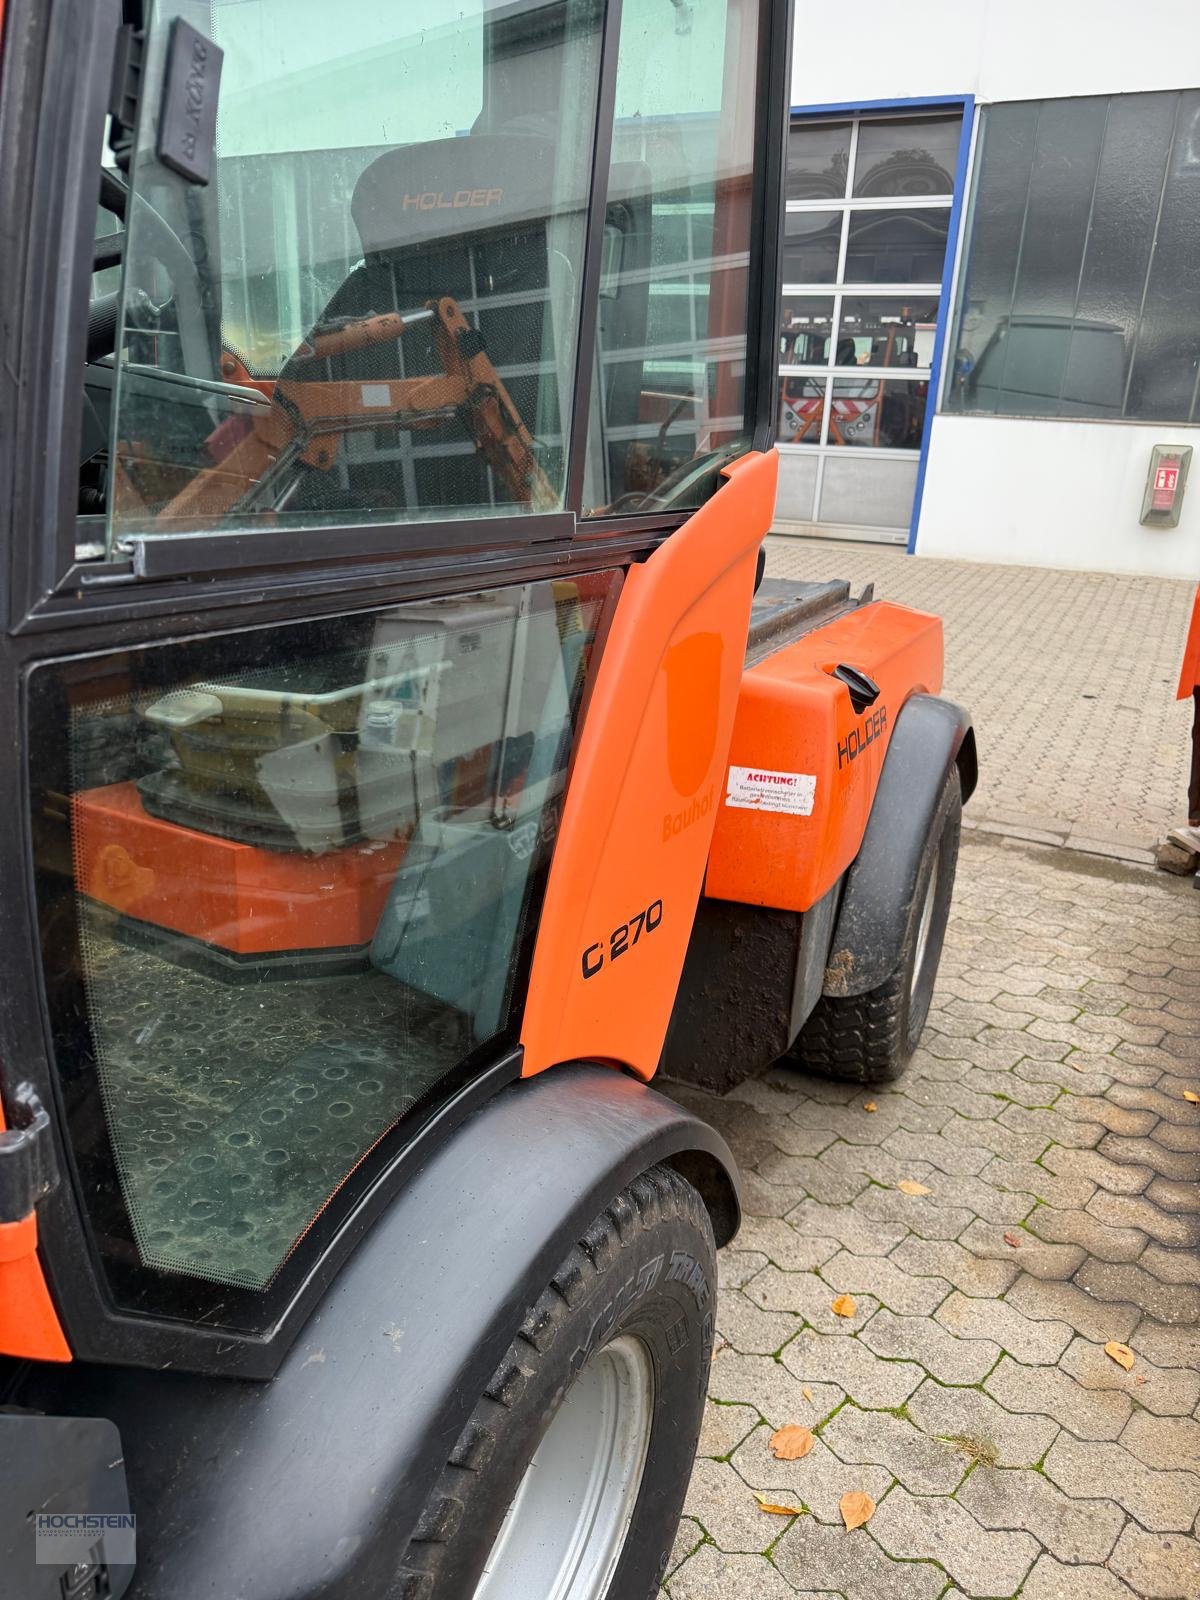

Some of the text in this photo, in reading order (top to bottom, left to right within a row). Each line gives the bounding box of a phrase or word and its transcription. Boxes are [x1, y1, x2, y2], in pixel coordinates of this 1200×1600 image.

[402, 187, 504, 211] HOLDER
[837, 706, 888, 770] HOLDER
[746, 773, 798, 787] ACHTUNG!
[662, 784, 714, 843] Bauhof
[609, 898, 663, 962] 270
